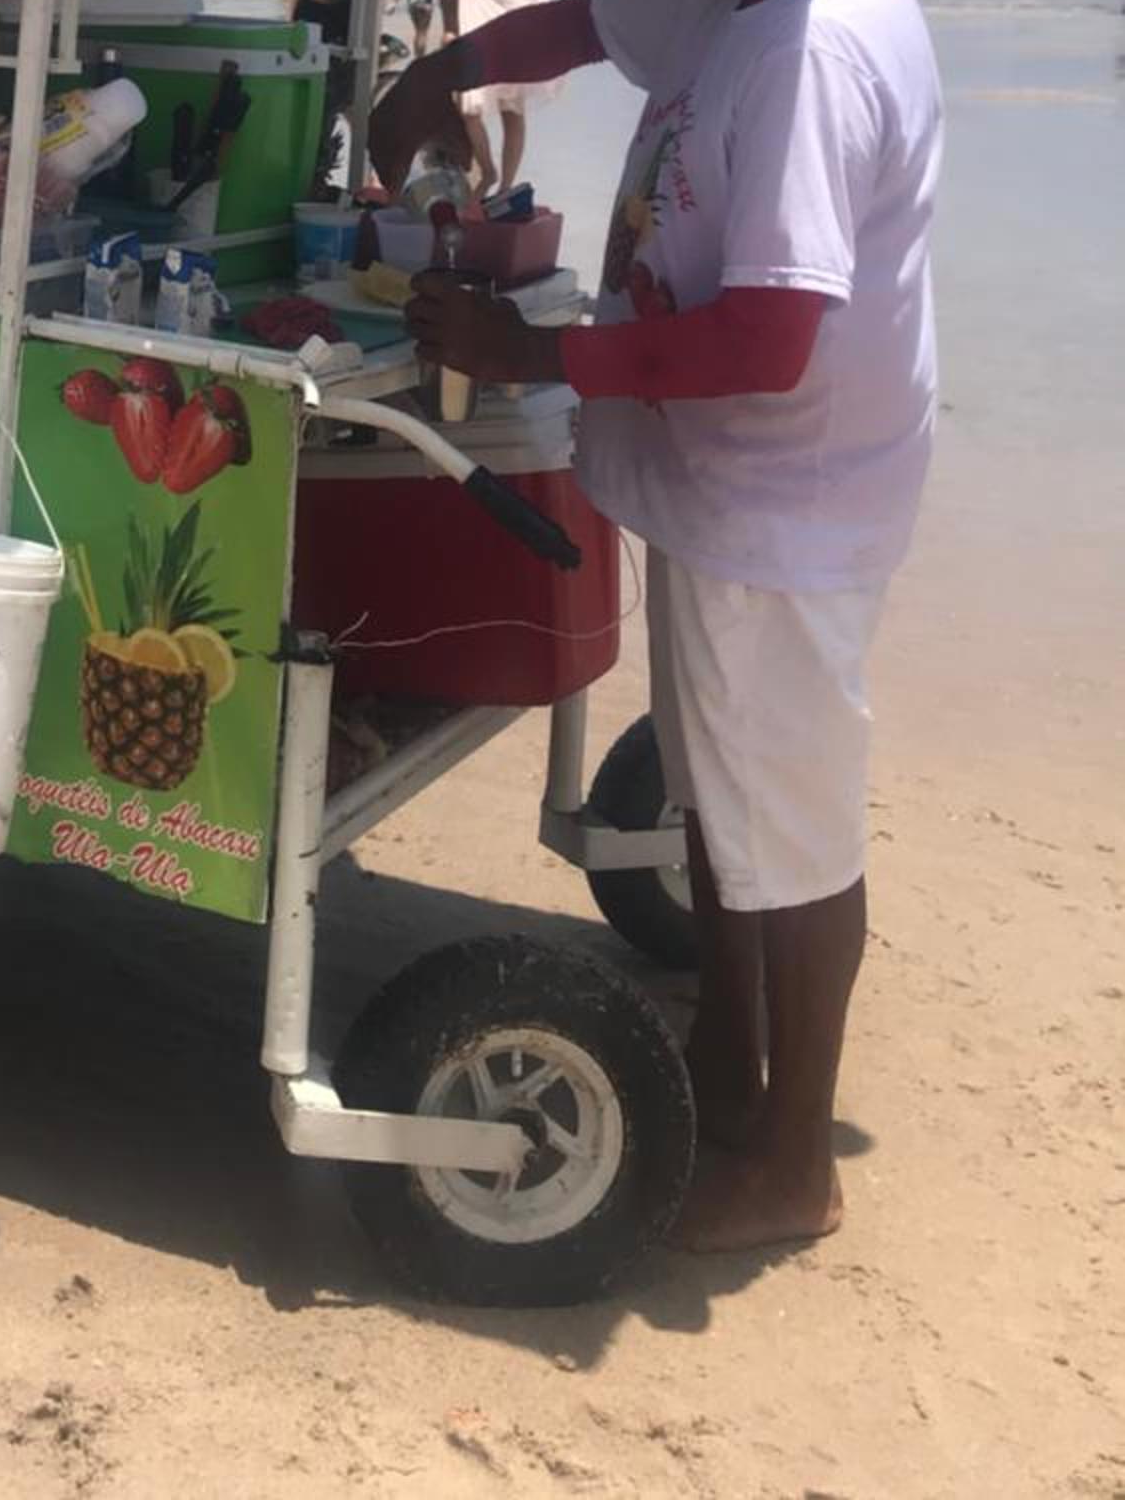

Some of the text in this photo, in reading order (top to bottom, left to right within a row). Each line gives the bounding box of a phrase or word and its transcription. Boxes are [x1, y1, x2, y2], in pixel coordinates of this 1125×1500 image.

[17, 773, 262, 861] oquetéis de Abacaxi
